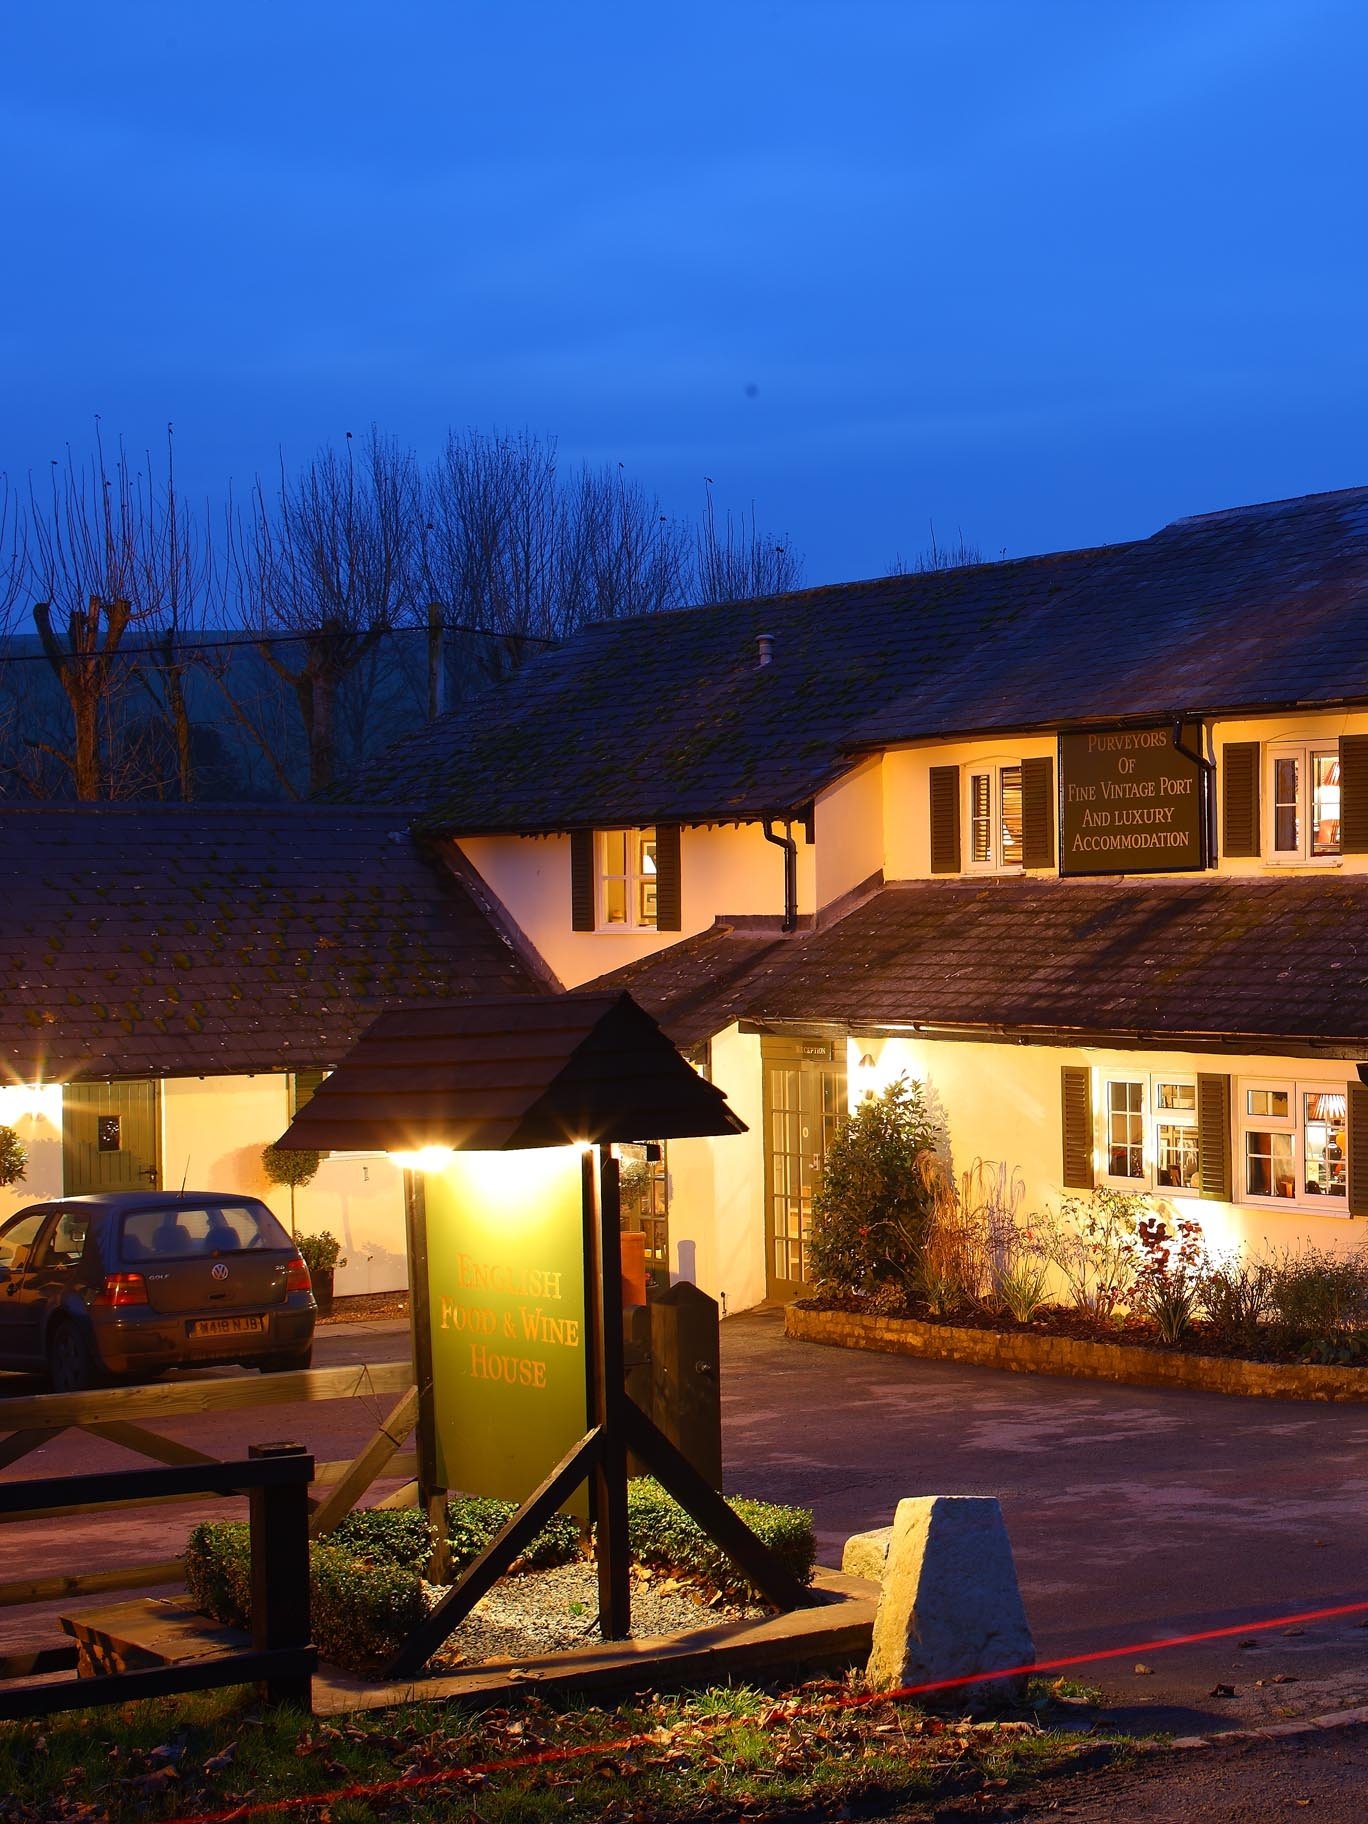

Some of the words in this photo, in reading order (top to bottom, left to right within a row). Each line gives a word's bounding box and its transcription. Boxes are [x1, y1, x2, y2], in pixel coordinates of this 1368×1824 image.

[1088, 731, 1167, 752] PURVEYORS
[1118, 757, 1136, 774] OF
[1067, 783, 1097, 802] FINE
[1100, 781, 1156, 800] VINTAGE
[1159, 777, 1193, 796] PORT
[1082, 809, 1111, 828] AND
[1114, 807, 1175, 826] LUXURY
[1072, 832, 1189, 852] ACCOMMODATION
[456, 1252, 562, 1300] ENGLISH
[440, 1295, 497, 1336] FOOD
[503, 1311, 518, 1339] &
[520, 1306, 579, 1347] WINE
[470, 1343, 547, 1388] HOUSE
